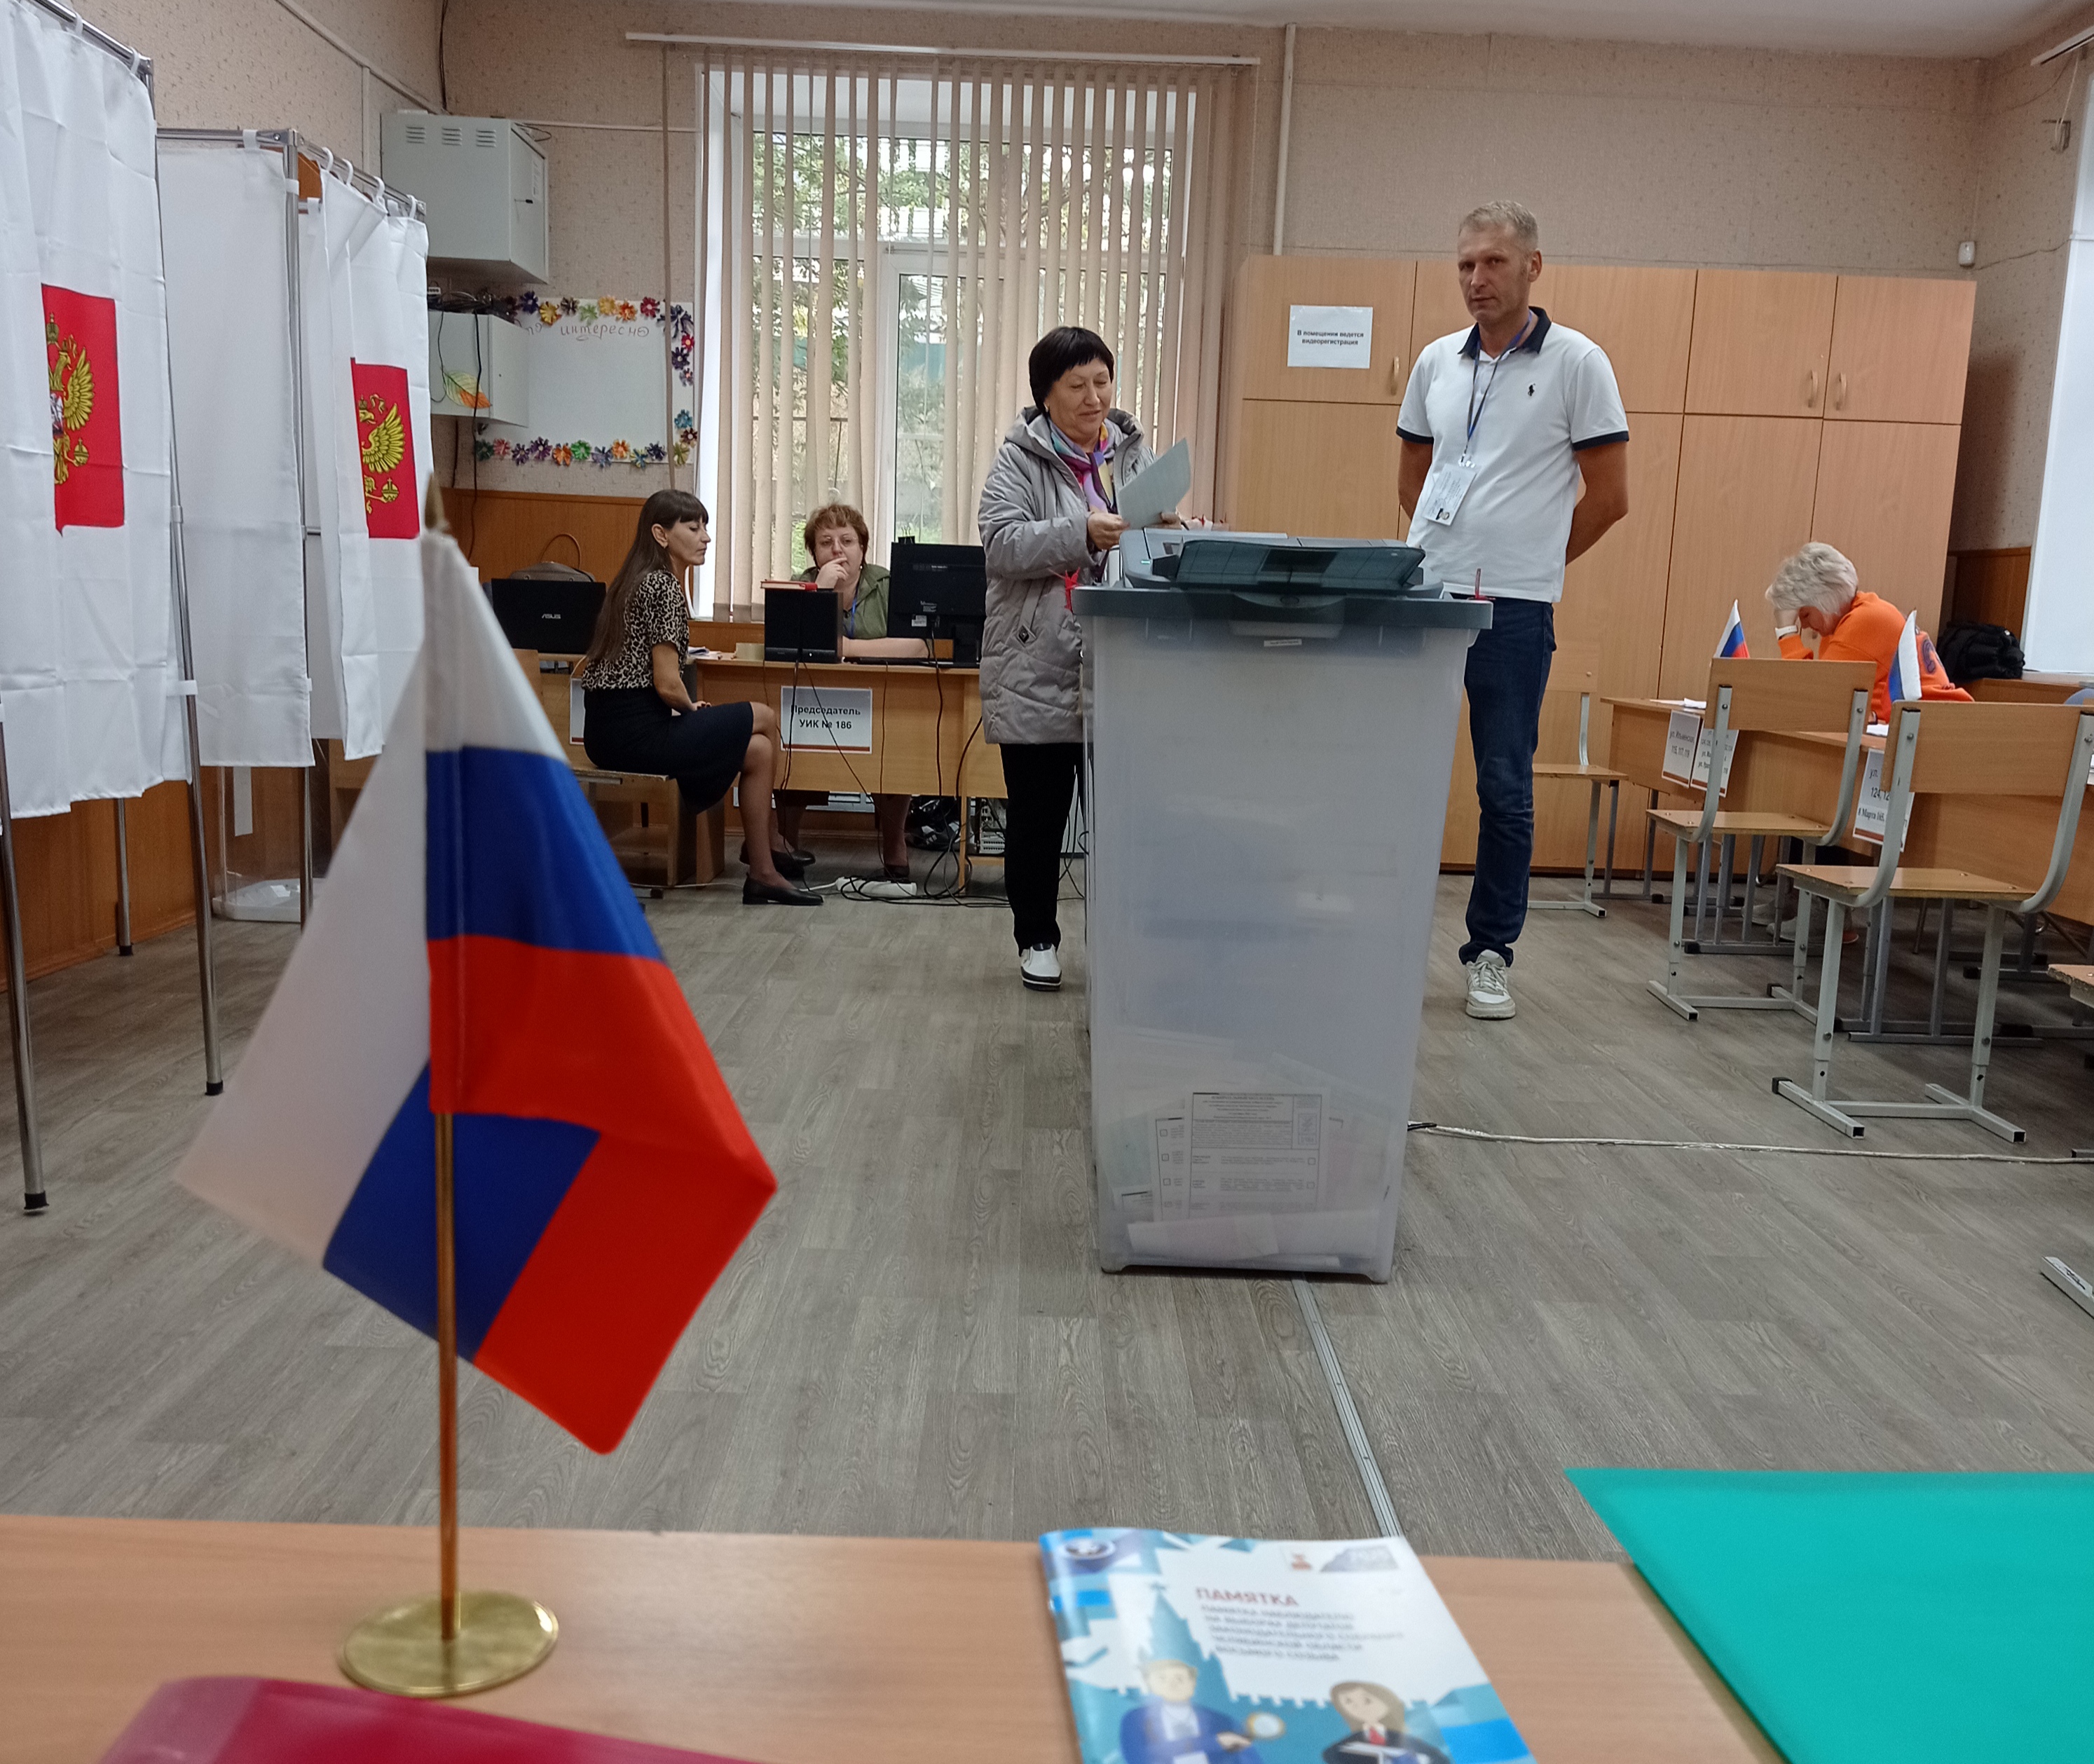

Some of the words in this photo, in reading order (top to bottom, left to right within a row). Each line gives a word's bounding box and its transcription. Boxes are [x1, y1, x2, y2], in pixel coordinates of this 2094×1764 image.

[561, 324, 649, 340] интересно
[800, 719, 819, 728] УИК
[836, 720, 851, 730] 186
[1869, 769, 1878, 779] ул.
[1862, 809, 1876, 821] Марта
[1196, 1587, 1299, 1606] ПАМЯТКА
